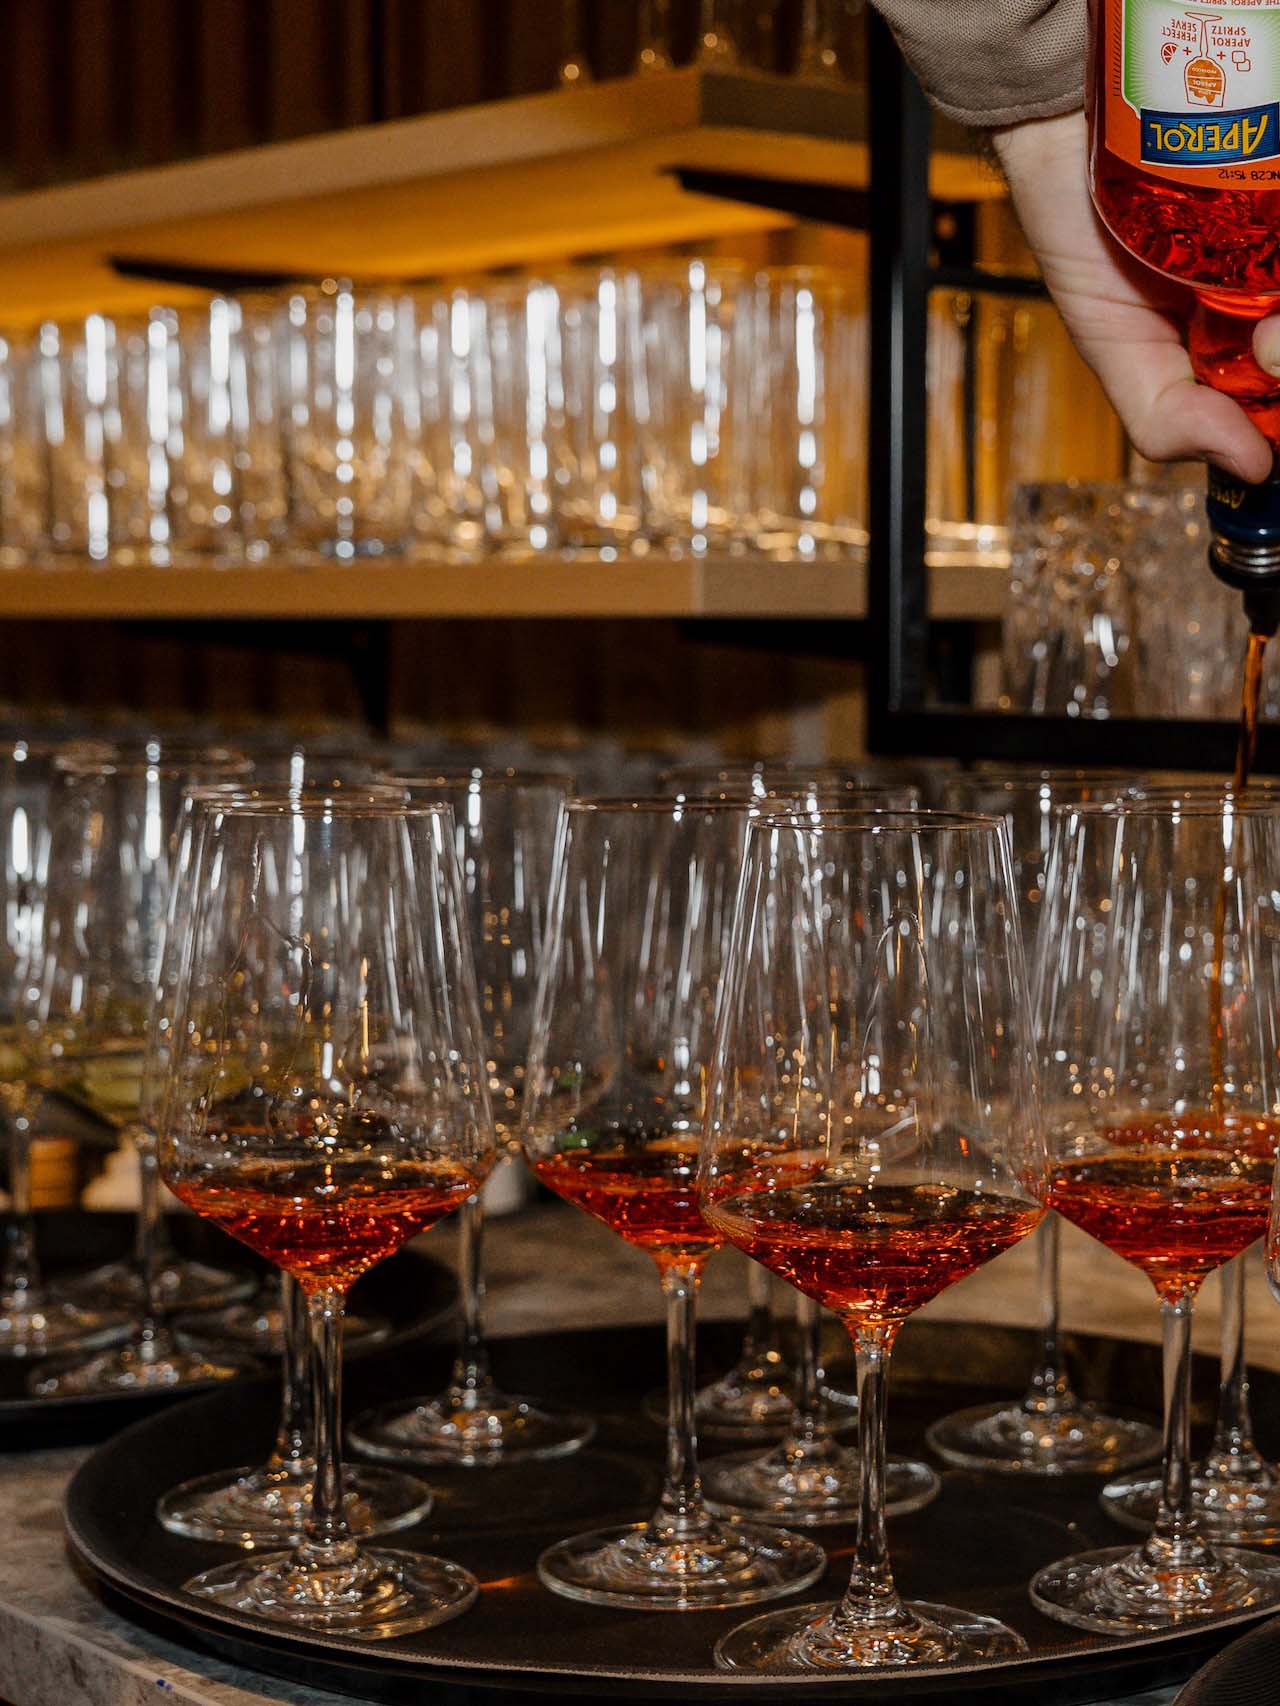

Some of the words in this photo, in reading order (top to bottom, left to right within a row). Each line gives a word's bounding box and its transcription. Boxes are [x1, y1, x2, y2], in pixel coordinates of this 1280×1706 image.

[1171, 19, 1197, 32] SERVE
[1211, 26, 1246, 36] SPRITZ
[1161, 26, 1197, 42] PERFECT
[1211, 37, 1251, 48] APEROL
[1192, 80, 1216, 88] APEROL
[1150, 114, 1268, 154] APEROL
[1218, 168, 1246, 180] 15:12
